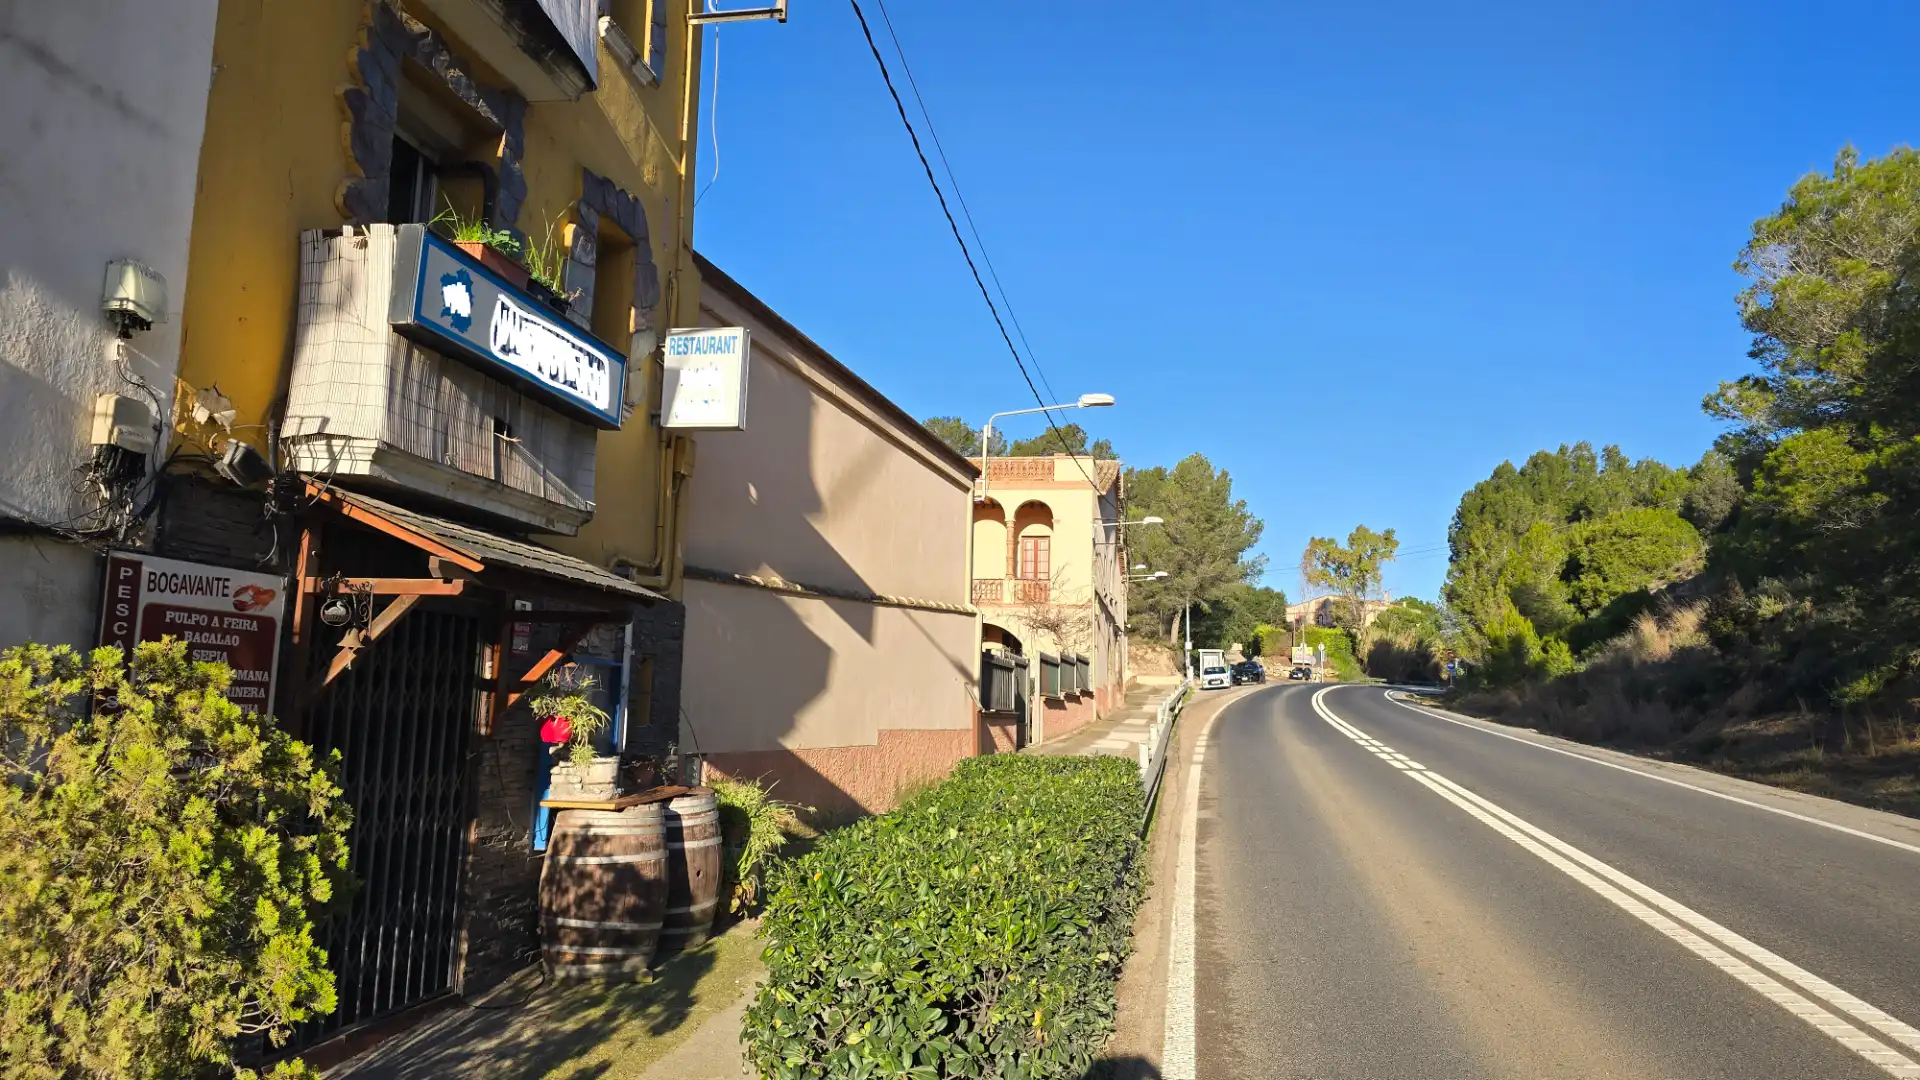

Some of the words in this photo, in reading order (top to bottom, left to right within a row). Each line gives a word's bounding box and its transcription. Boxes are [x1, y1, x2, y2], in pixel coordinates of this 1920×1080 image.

[669, 336, 738, 356] RESTAURANT
[147, 571, 231, 598] BOGAVANTE
[165, 611, 208, 626] PULPO
[211, 616, 220, 627] A
[223, 617, 258, 631] FEIRA
[184, 631, 240, 647] BACALAO
[192, 649, 229, 664] SEPIA
[234, 669, 270, 682] MANA
